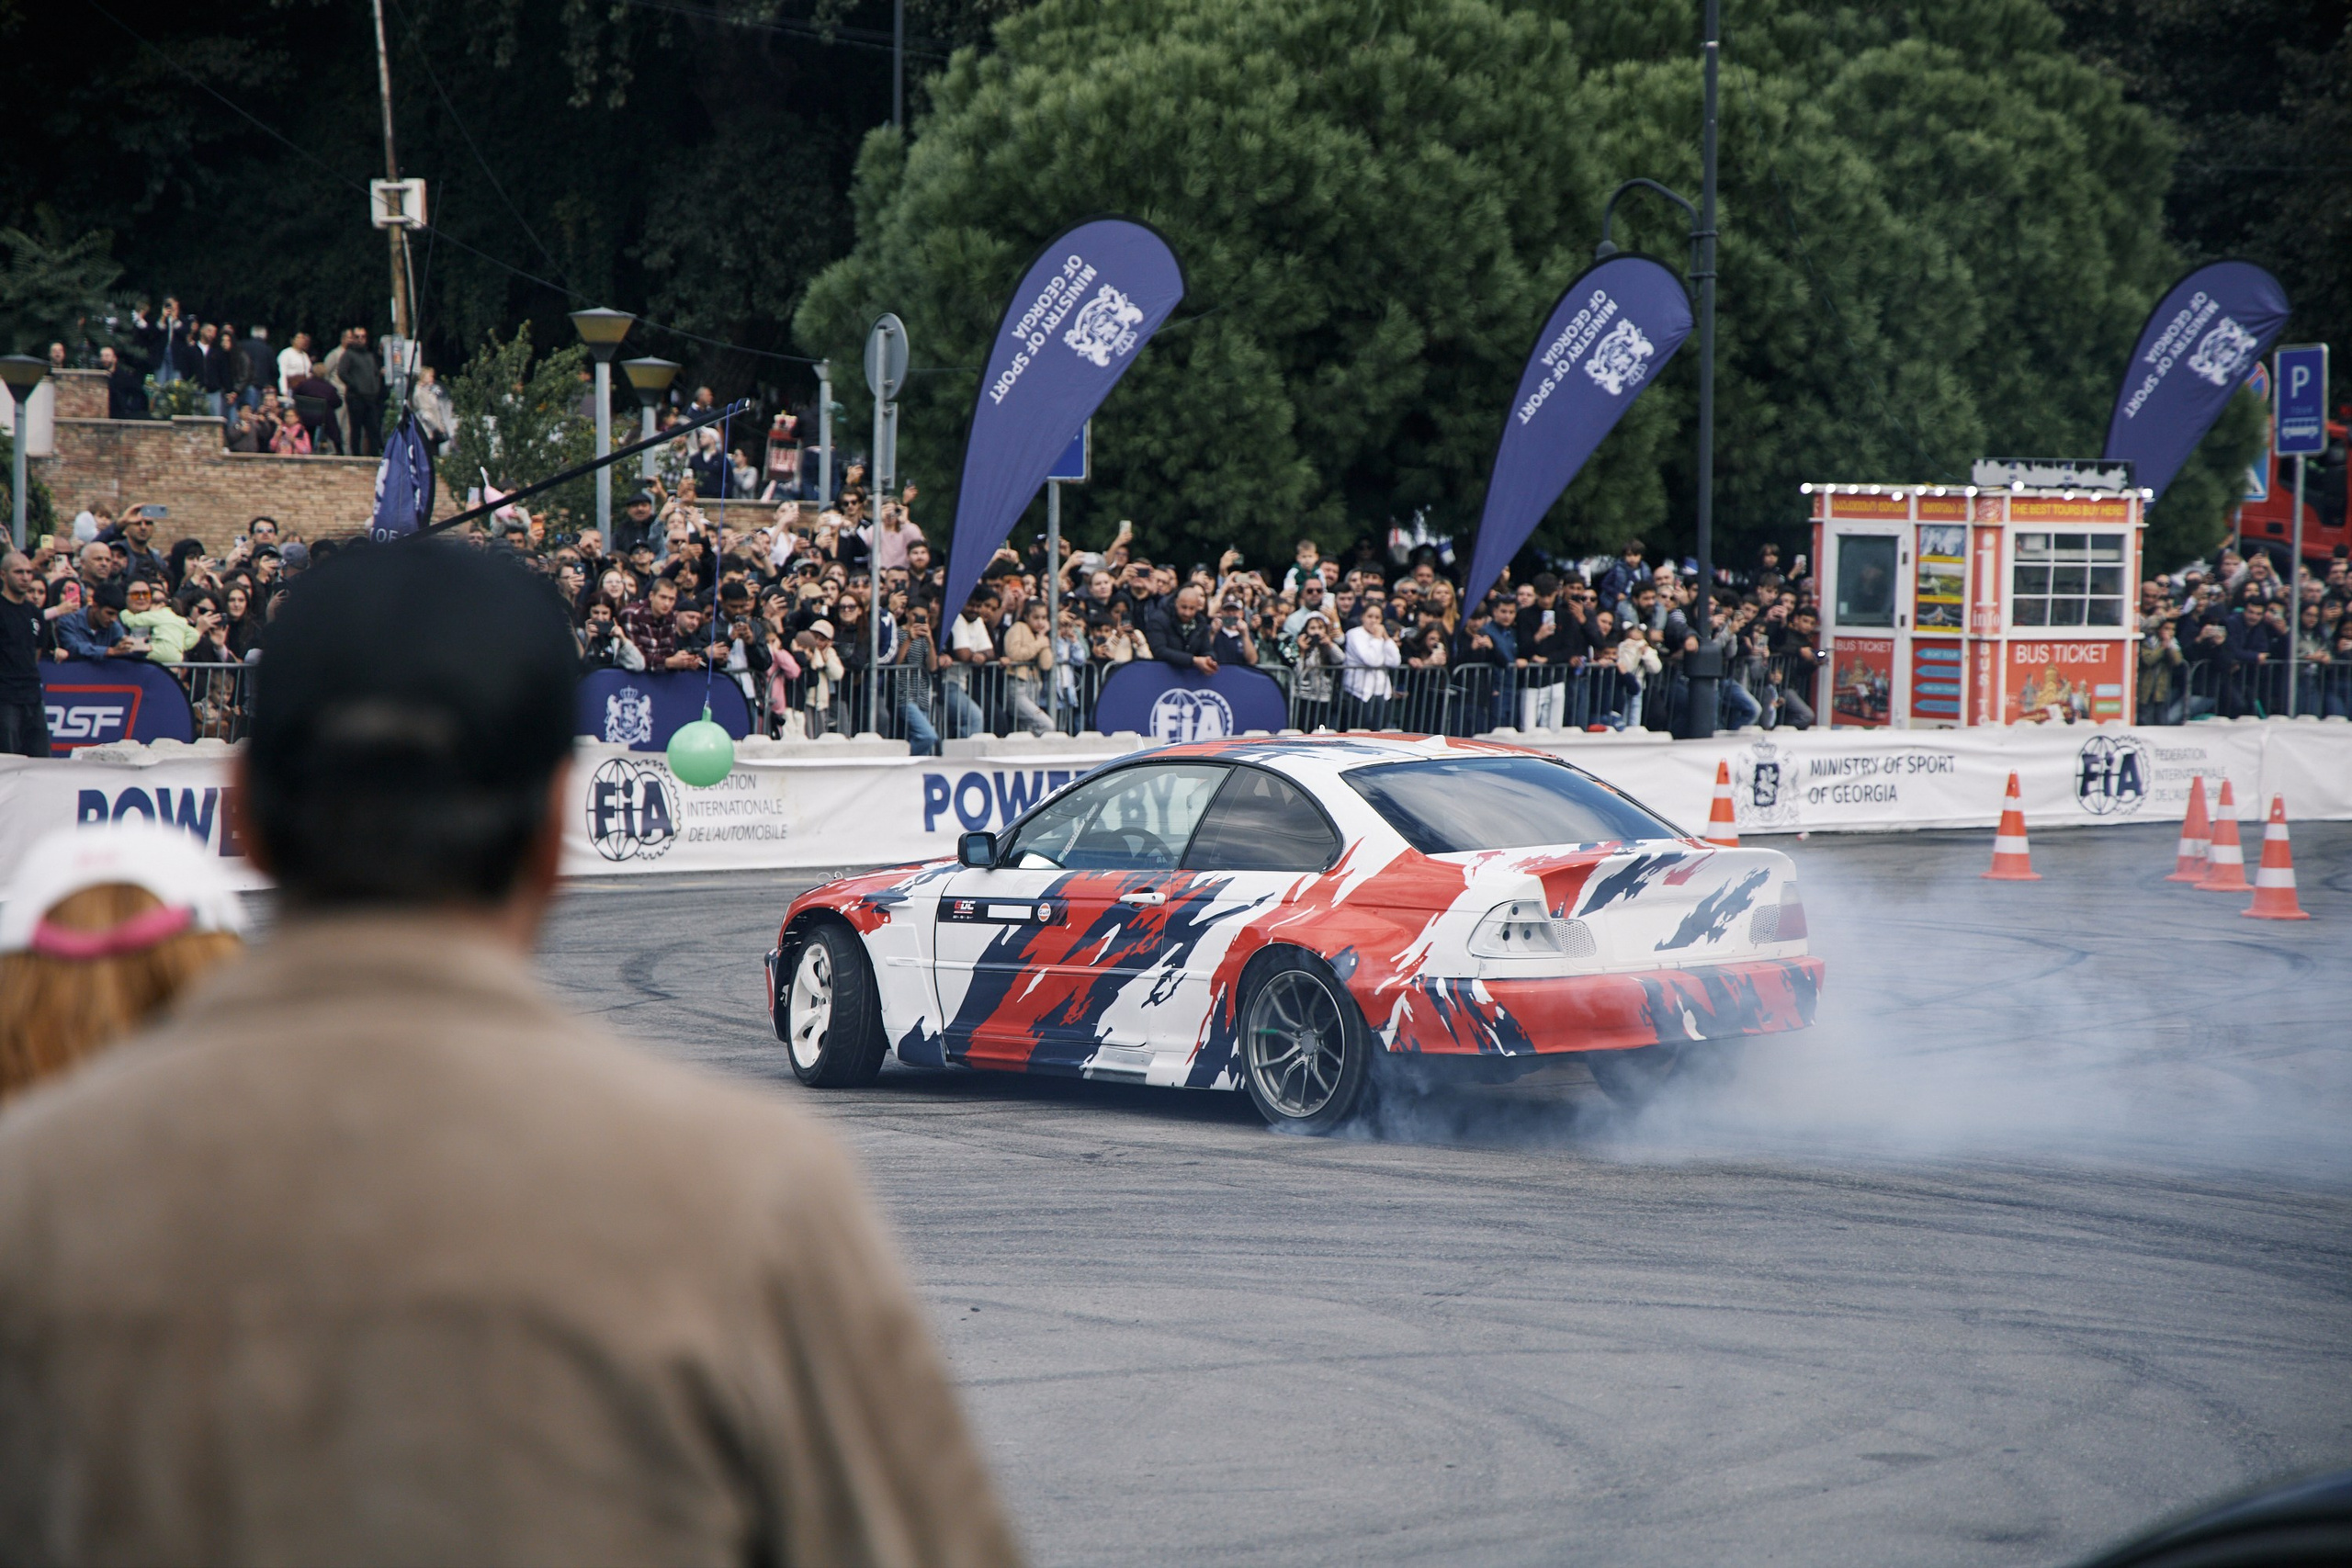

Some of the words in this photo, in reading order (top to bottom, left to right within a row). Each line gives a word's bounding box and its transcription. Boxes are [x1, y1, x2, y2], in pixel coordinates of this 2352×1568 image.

[1063, 254, 1082, 279] OF
[1012, 276, 1066, 340] GEORGIA
[1041, 264, 1098, 335] MINISTRY
[1589, 289, 1607, 312] OF
[2188, 291, 2208, 311] OF
[1540, 309, 1591, 367] GEORGIA
[1567, 299, 1618, 363] MINISTRY
[2143, 309, 2192, 365] GEORGIA
[2169, 299, 2220, 361] MINISTRY
[1025, 332, 1046, 356] OF
[989, 352, 1030, 405] SPORT
[1552, 362, 1570, 382] OF
[2155, 356, 2173, 378] OF
[2291, 366, 2310, 399] P
[1517, 378, 1555, 425] SPORT
[2123, 374, 2159, 420] SPORT
[2030, 503, 2051, 515] BEST
[1973, 610, 2000, 627] info
[1837, 639, 1856, 651] BUS
[1858, 640, 1892, 653] TICKET
[2015, 644, 2050, 664] BUS
[2052, 643, 2110, 663] TICKET
[45, 705, 124, 738] ASF
[1810, 757, 1879, 776] MINISTRY
[1883, 756, 1905, 774] OF
[1907, 756, 1955, 773] SPORT
[1808, 786, 1827, 804] OF
[1833, 784, 1898, 804] GEORGIA
[686, 798, 783, 817] INTERNATIONALE
[954, 900, 976, 910] GDC
